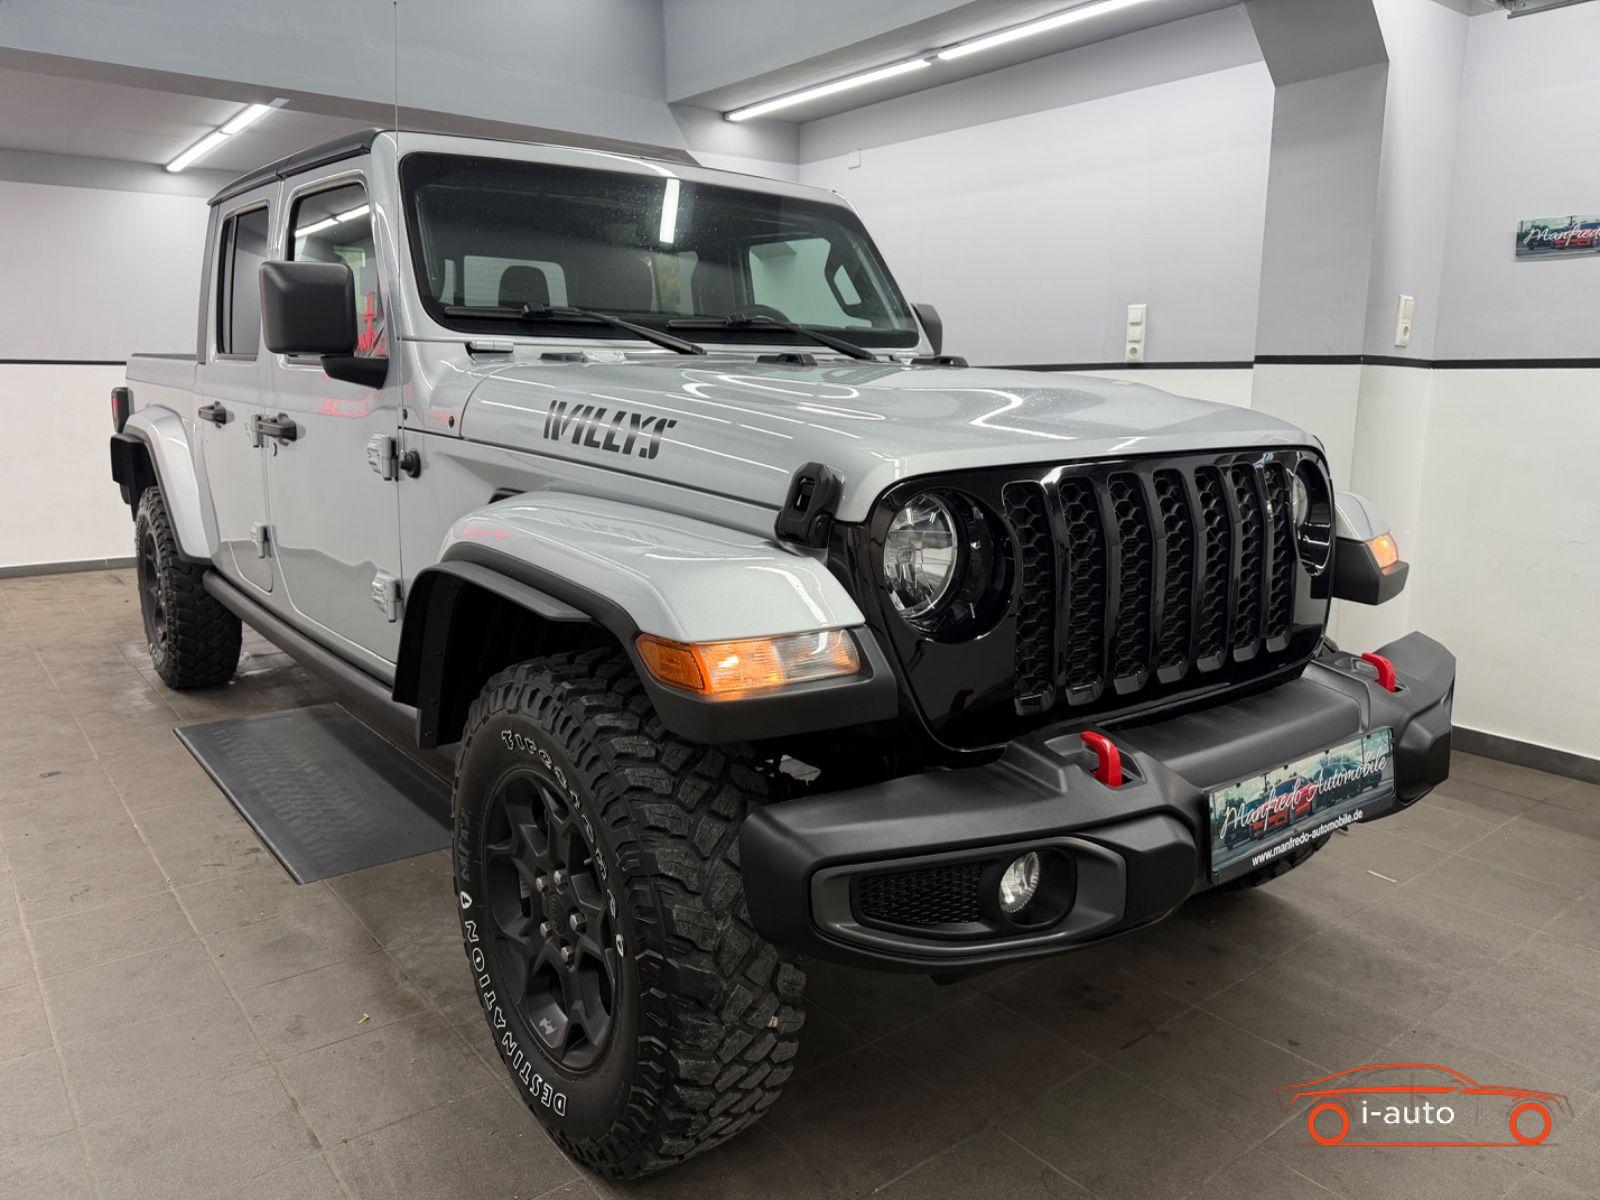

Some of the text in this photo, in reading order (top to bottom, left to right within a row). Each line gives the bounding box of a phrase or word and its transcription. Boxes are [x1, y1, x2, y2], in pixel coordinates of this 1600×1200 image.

[543, 400, 677, 459] WILLYS
[1219, 746, 1387, 840] Manfredo Automobile
[1252, 809, 1363, 867] www.manfredo-automobile.de
[465, 920, 567, 1116] DESTINATION
